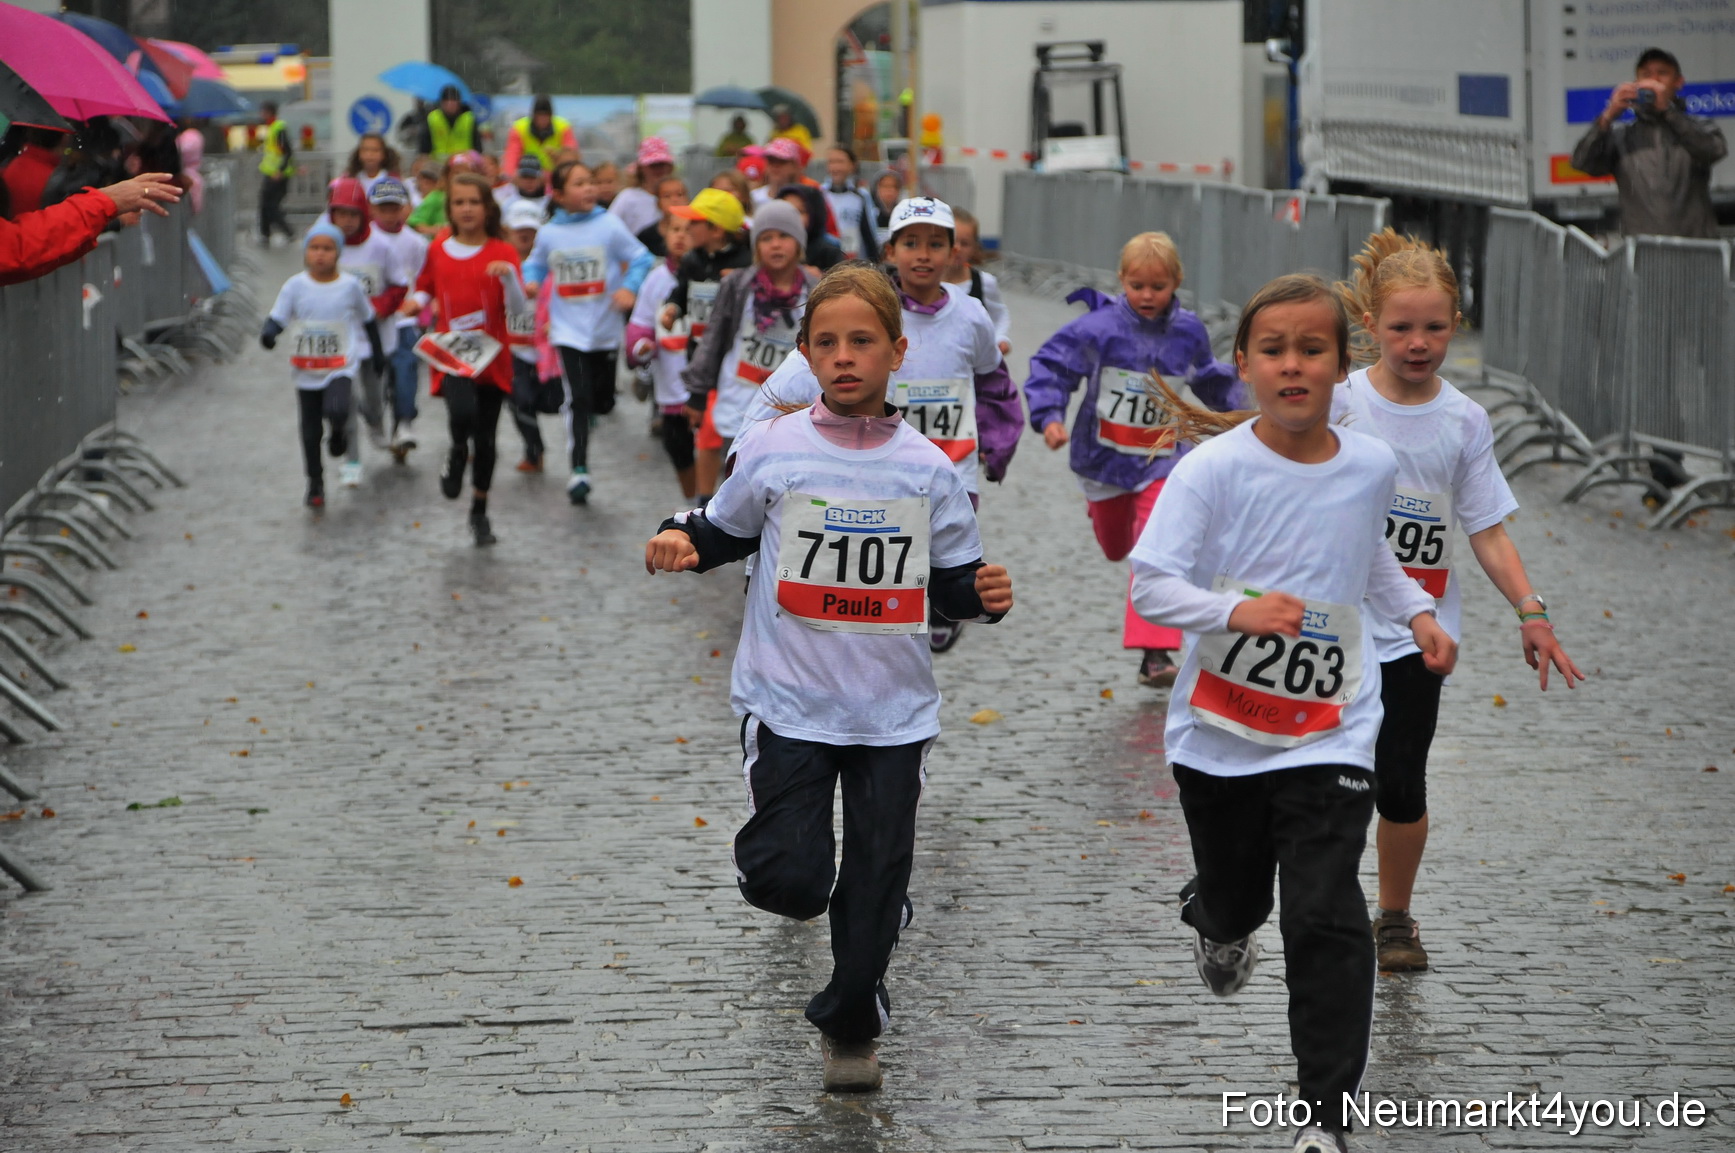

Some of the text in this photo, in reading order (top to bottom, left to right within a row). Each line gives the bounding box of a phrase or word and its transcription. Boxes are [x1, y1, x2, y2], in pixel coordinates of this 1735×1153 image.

[1392, 494, 1432, 513] OCK
[825, 507, 886, 524] BOCK
[1385, 516, 1447, 566] 95
[798, 530, 912, 585] 7107
[782, 569, 789, 579] 3
[917, 576, 925, 586] W
[822, 593, 882, 617] Paula
[1302, 610, 1330, 630] CK
[1220, 631, 1345, 699] 7263
[1226, 687, 1281, 724] Marie
